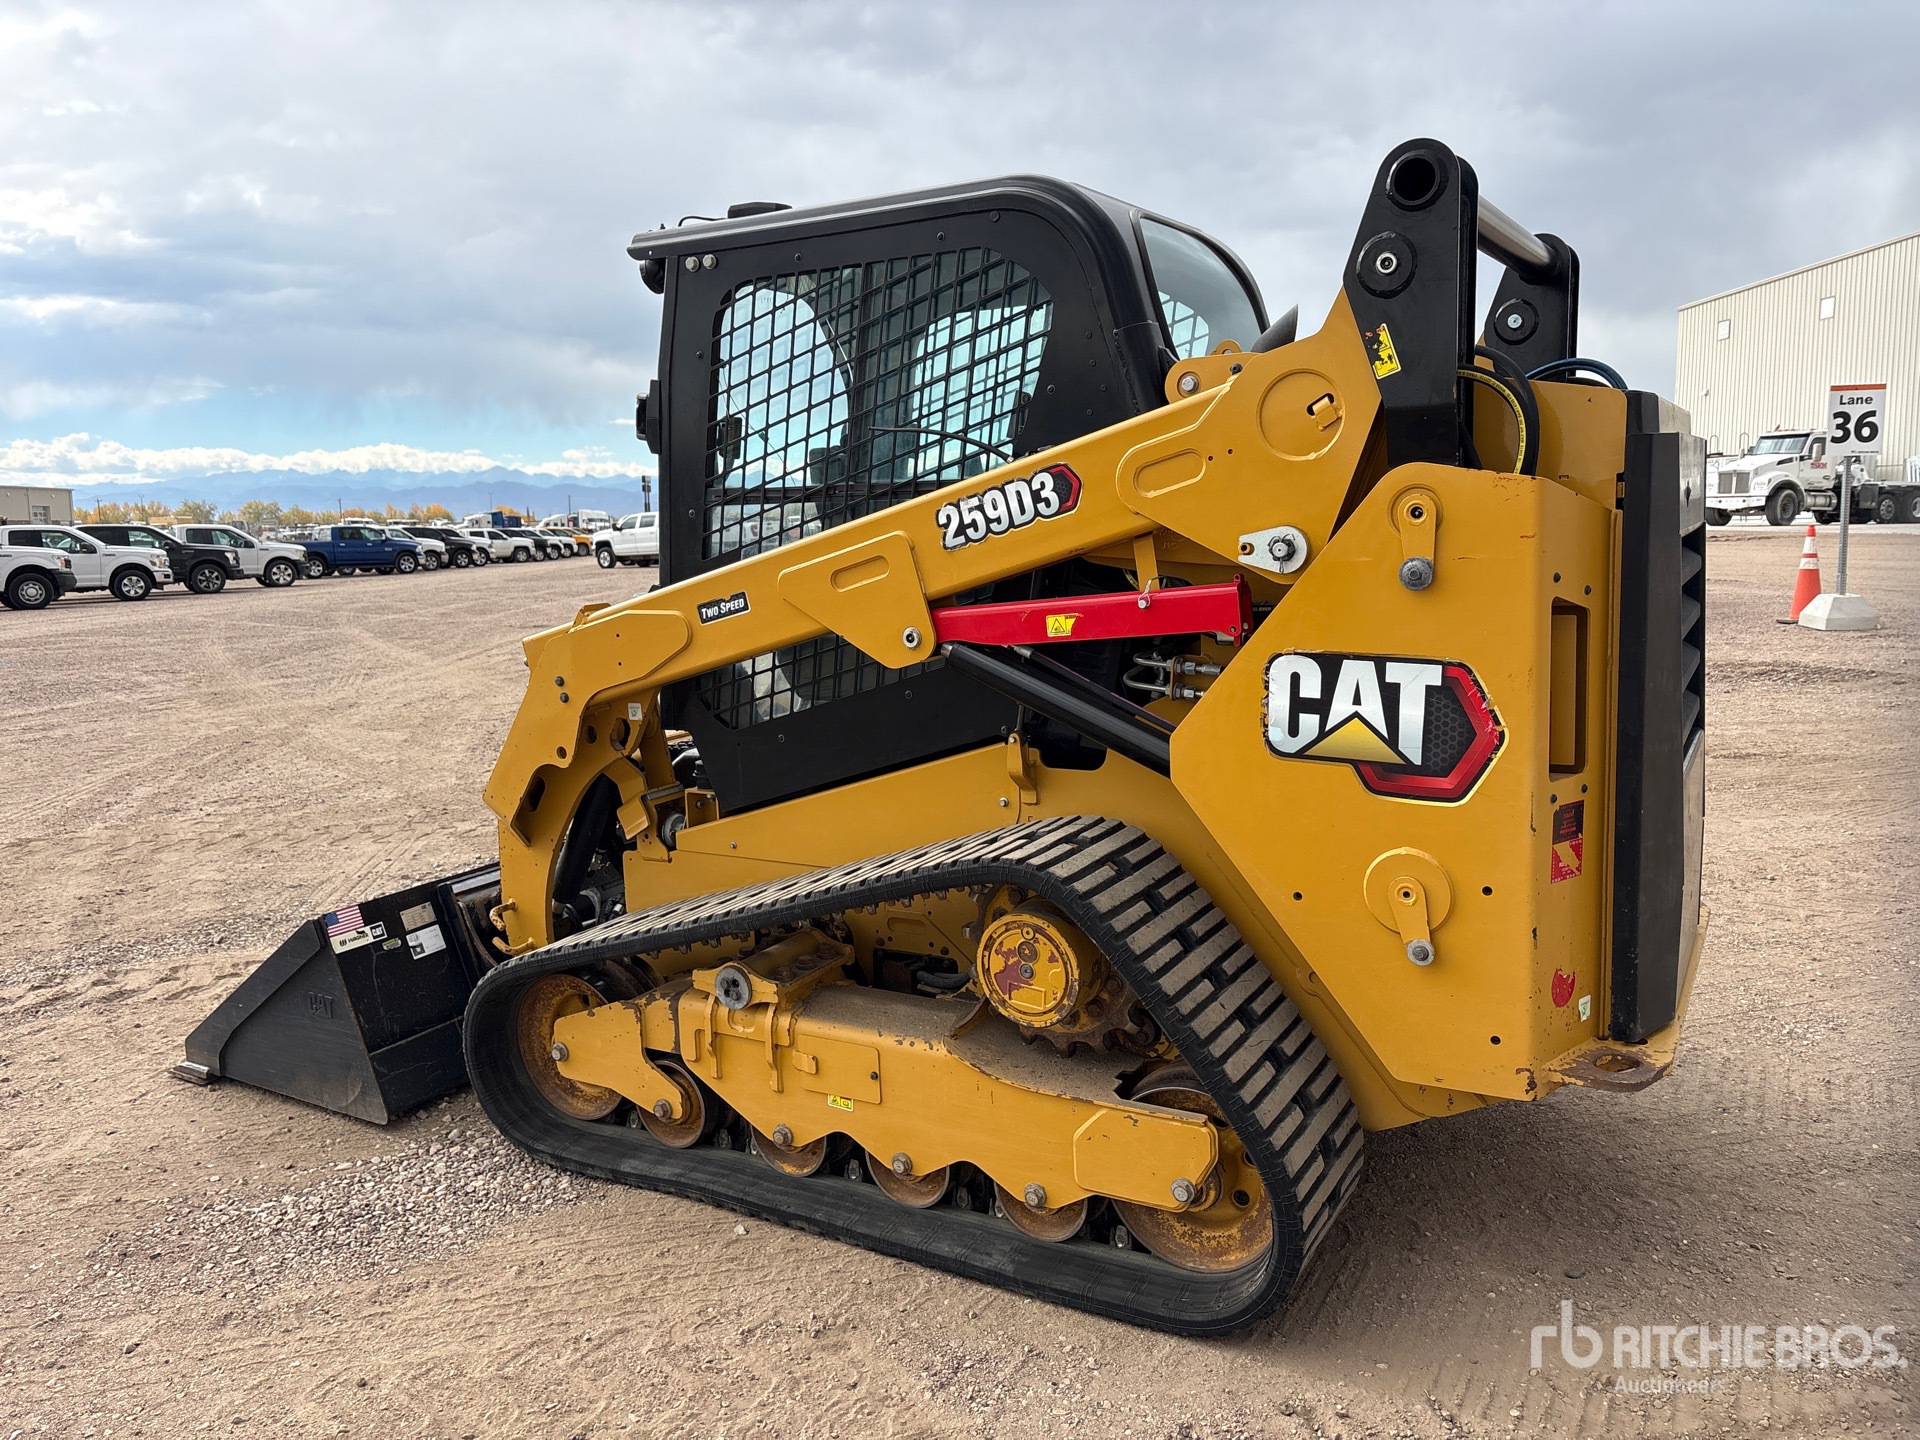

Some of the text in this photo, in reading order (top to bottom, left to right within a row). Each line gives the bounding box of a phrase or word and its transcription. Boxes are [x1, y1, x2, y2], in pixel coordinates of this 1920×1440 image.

[1830, 409, 1879, 444] 36
[1839, 394, 1873, 406] Lane
[938, 472, 1060, 548] 259D3
[1268, 654, 1442, 766] CAT
